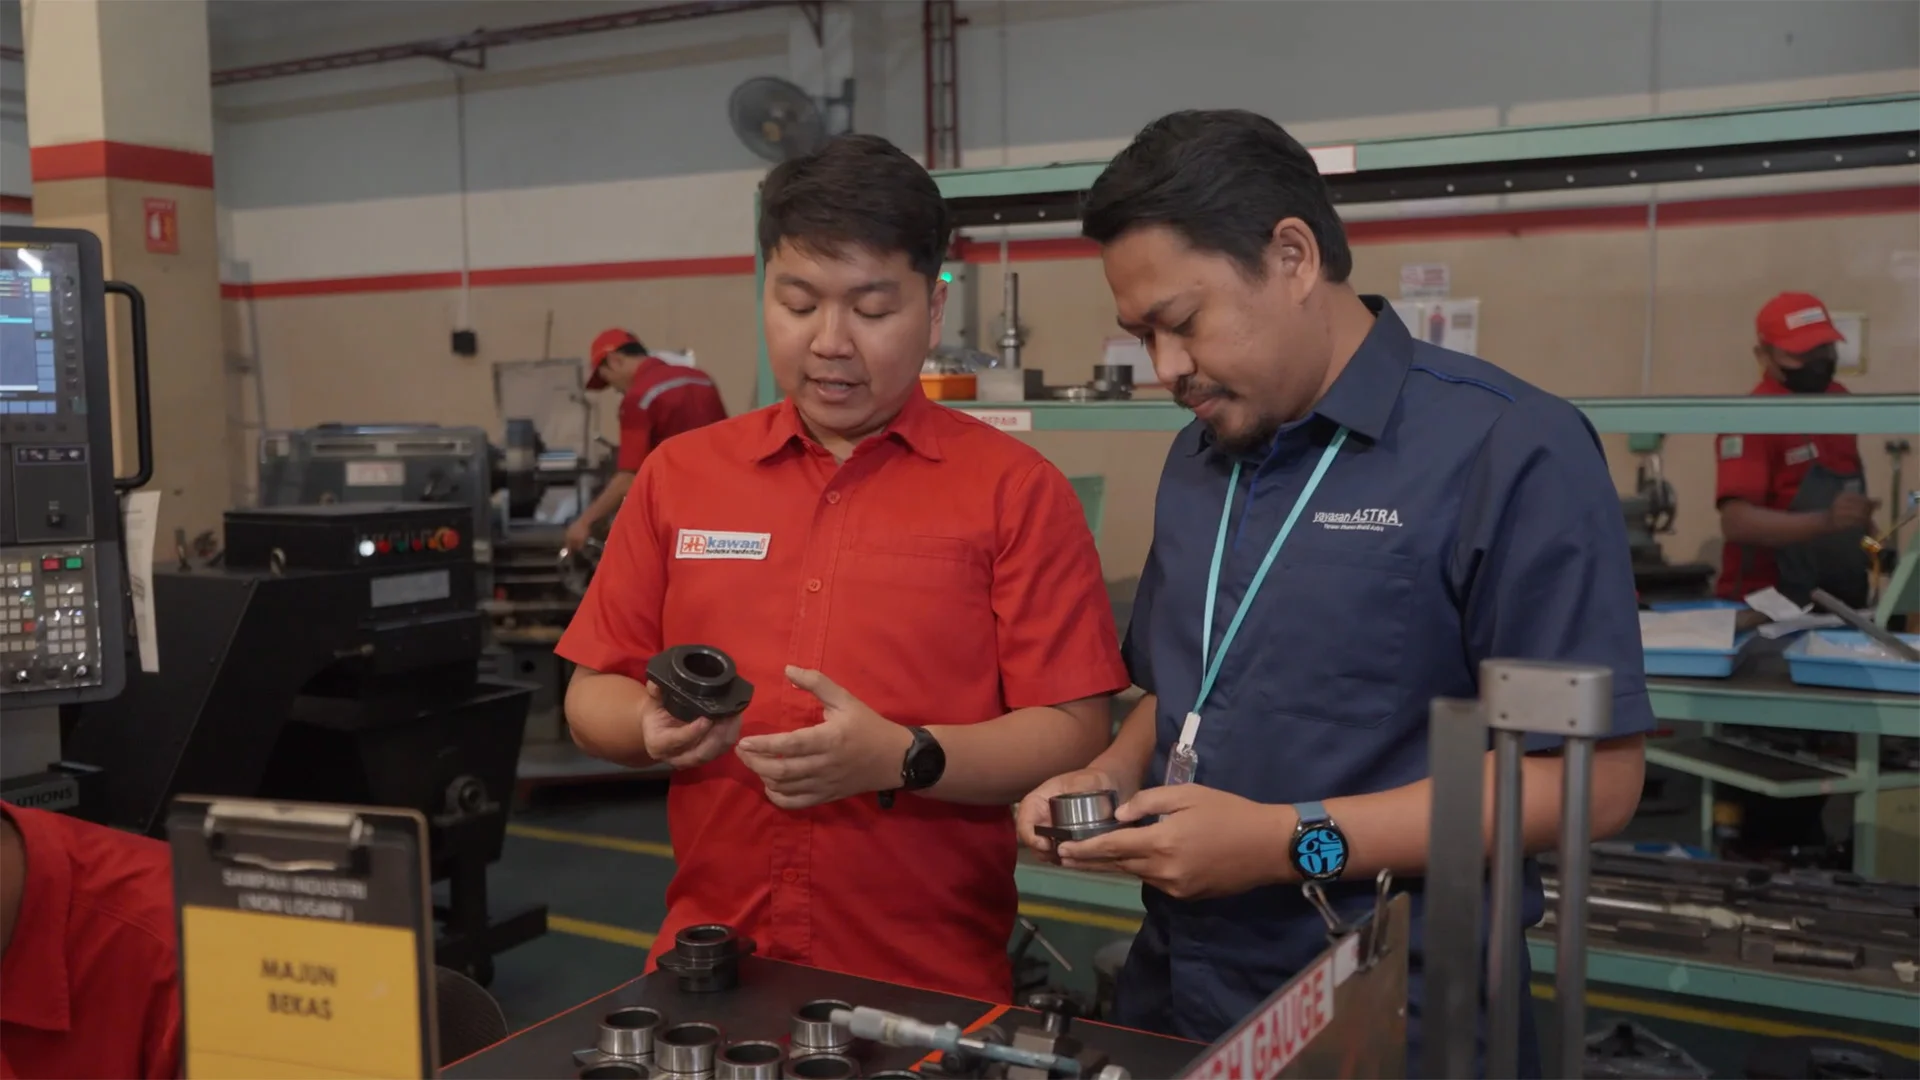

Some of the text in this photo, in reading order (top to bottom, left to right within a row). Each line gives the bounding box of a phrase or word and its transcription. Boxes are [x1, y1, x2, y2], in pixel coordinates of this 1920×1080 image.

[1351, 508, 1399, 524] ASTRA
[15, 787, 72, 806] UTIONS
[293, 875, 368, 899] INDUSTRI
[261, 958, 336, 986] MAJUN
[268, 992, 332, 1020] BEKAS
[1253, 970, 1325, 1080] GAUGE
